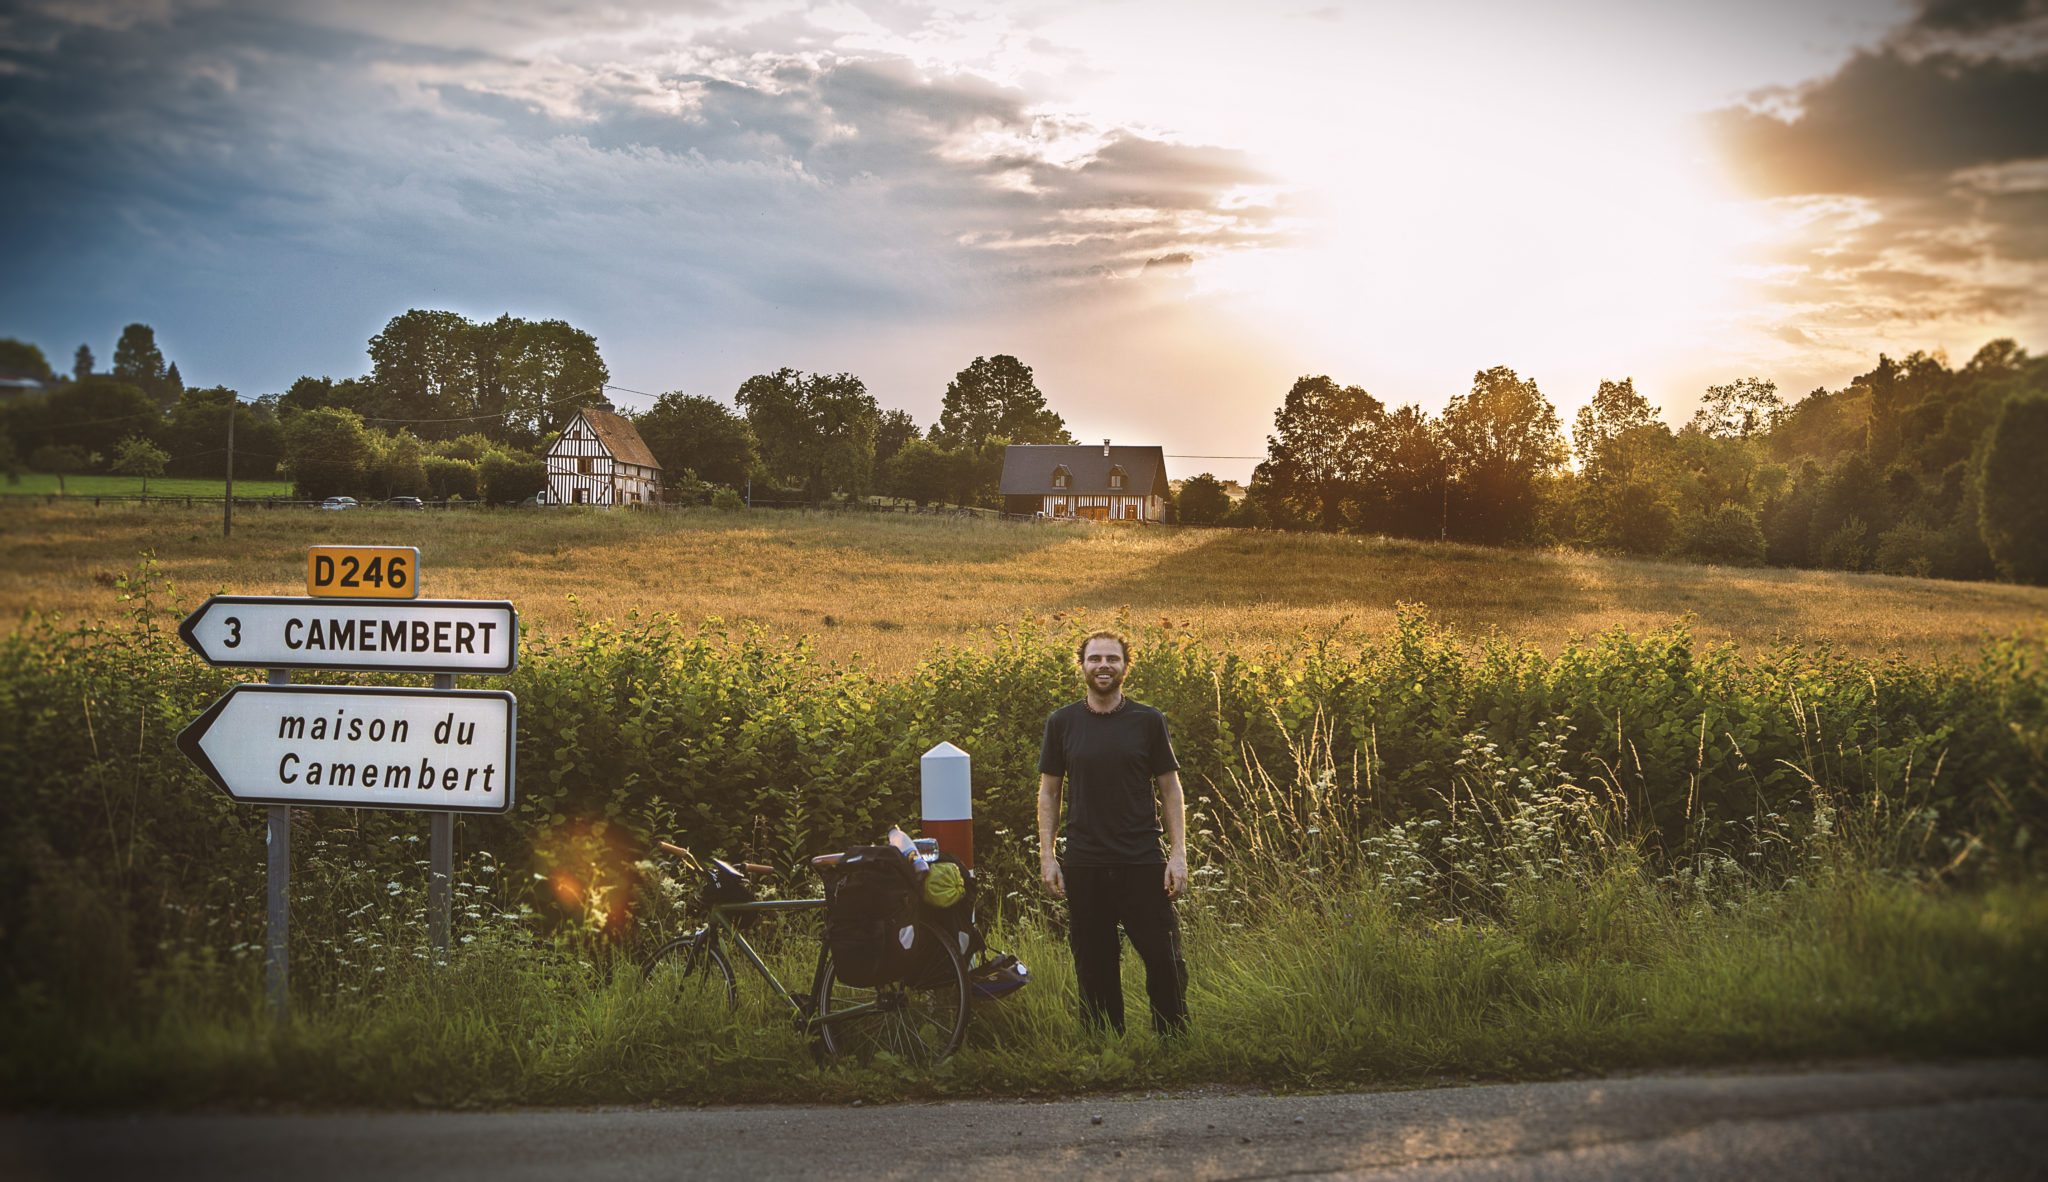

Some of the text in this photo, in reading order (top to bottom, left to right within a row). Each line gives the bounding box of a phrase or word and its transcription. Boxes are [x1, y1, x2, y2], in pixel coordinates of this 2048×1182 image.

[314, 555, 407, 589] D246
[223, 616, 497, 654] 3 CAMEMBERT
[278, 709, 476, 745] maison du
[278, 752, 496, 792] Camembert
